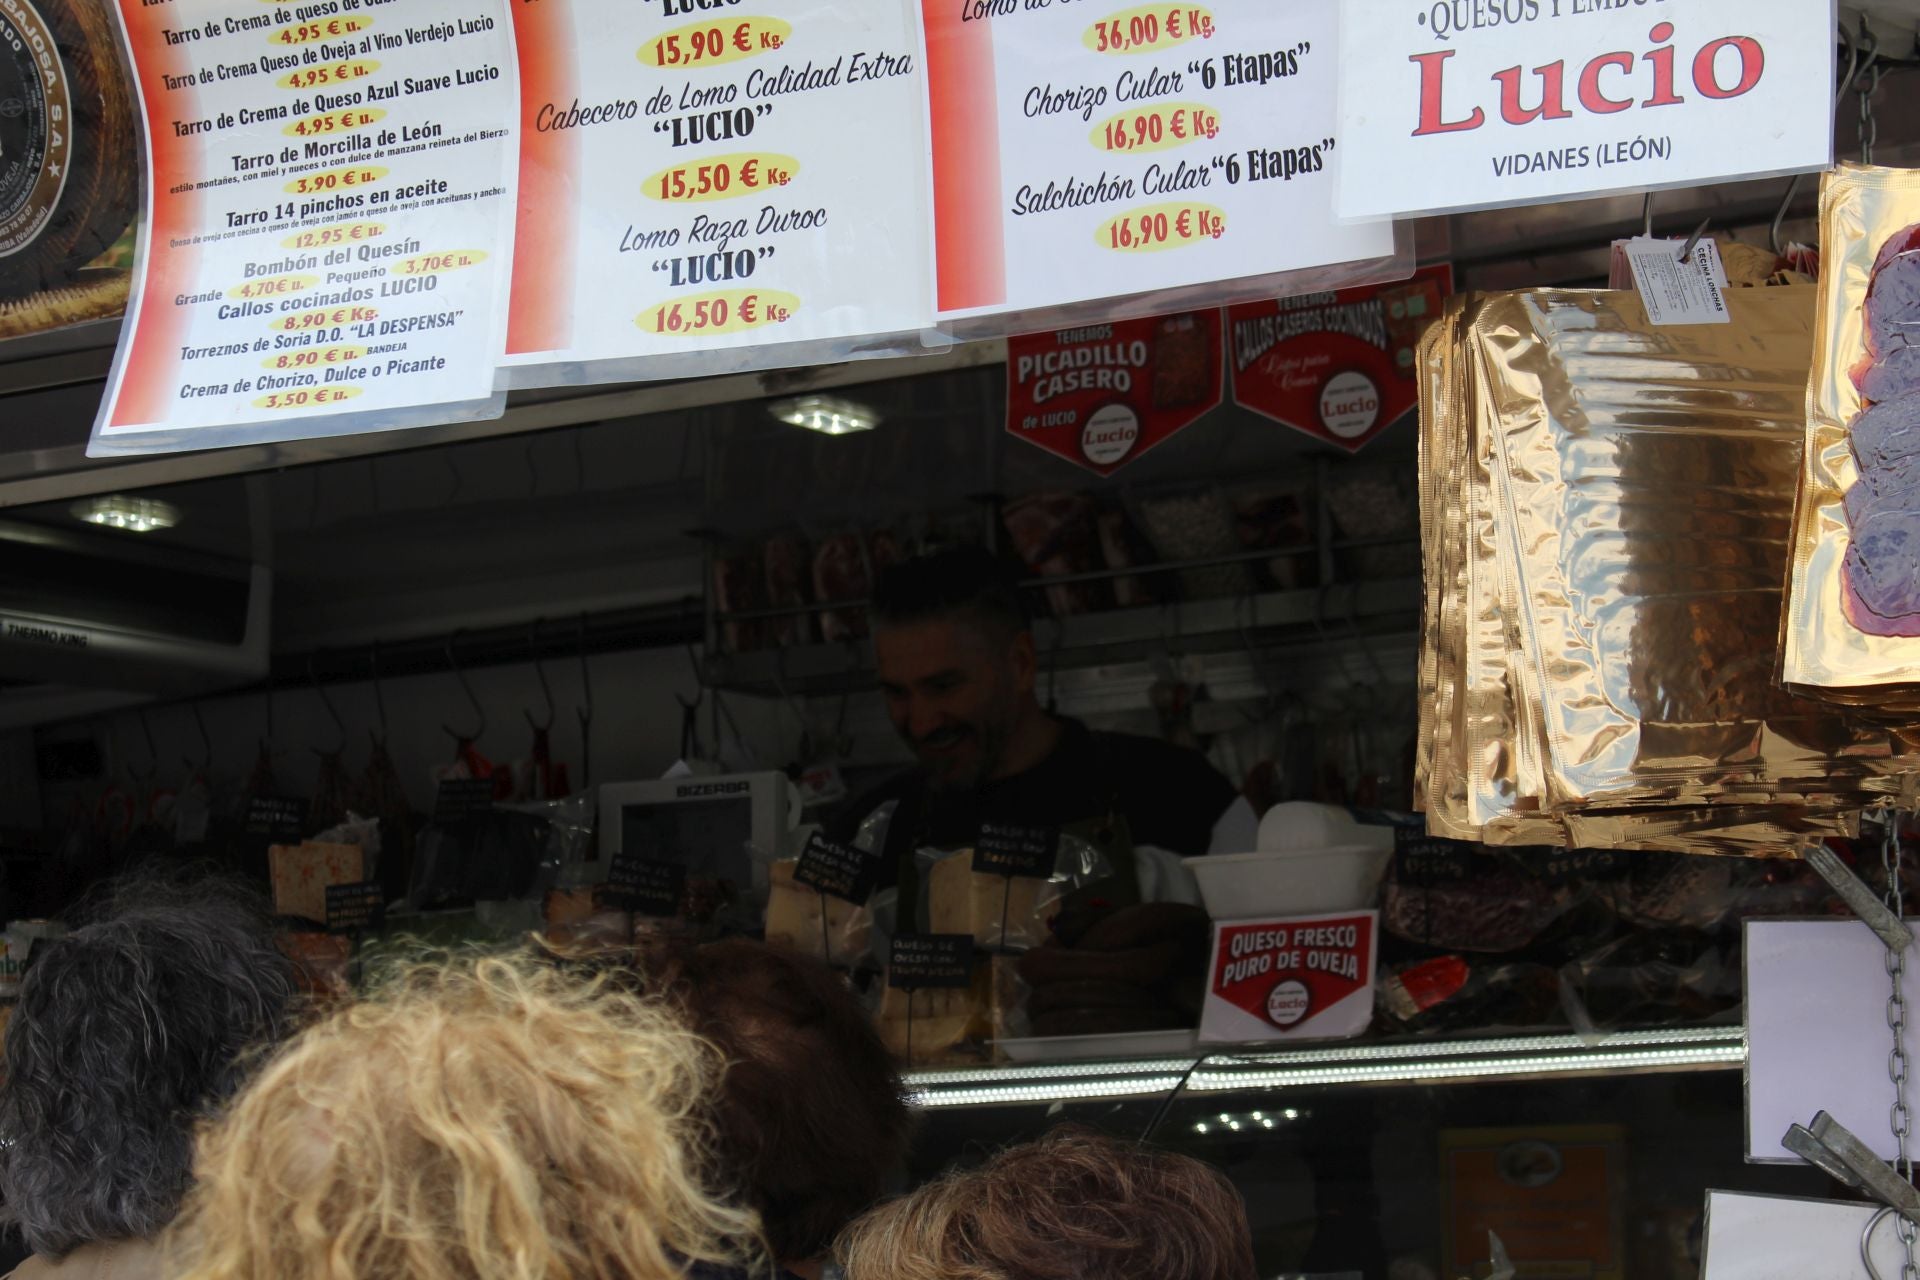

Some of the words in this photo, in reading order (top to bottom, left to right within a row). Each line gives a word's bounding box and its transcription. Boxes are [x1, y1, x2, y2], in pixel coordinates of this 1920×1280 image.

[162, 29, 200, 46] Tarro
[205, 22, 221, 38] de
[224, 13, 271, 36] Crema
[275, 8, 292, 24] de
[296, 3, 339, 24] queso
[281, 25, 320, 44] 4,95
[327, 20, 340, 35] €
[346, 20, 361, 33] u.
[962, 0, 1015, 22] Lomo
[1095, 20, 1158, 53] 36,00
[1165, 10, 1182, 38] €
[1189, 10, 1215, 38] Kg.
[0, 0, 56, 94] BAJOSA,
[162, 73, 196, 91] Tarro
[200, 68, 214, 83] de
[217, 61, 257, 80] Crema
[260, 53, 298, 75] Queso
[303, 50, 317, 65] de
[321, 41, 355, 62] Oveja
[360, 39, 371, 54] al
[374, 32, 402, 51] Vino
[407, 25, 454, 45] Verdejo
[458, 15, 494, 35] Lucio
[655, 30, 724, 66] 15,90
[733, 24, 752, 51] €
[760, 32, 783, 50] Kg.
[537, 99, 638, 132] Cabecero
[645, 86, 673, 114] de
[679, 83, 737, 111] Lomo
[746, 56, 842, 97] Calidad
[847, 51, 913, 83] Extra
[1024, 75, 1107, 121] Chorizo
[1115, 67, 1183, 102] Cular
[1409, 21, 1765, 136] Lucio
[172, 120, 211, 137] Tarro
[217, 114, 234, 129] de
[239, 106, 287, 126] Crema
[292, 101, 309, 116] de
[315, 92, 361, 113] Queso
[367, 82, 398, 102] Azul
[404, 75, 451, 96] Suave
[456, 64, 499, 86] Lucio
[232, 153, 274, 172] Tarro
[279, 148, 298, 164] de
[304, 134, 372, 158] Morcilla
[377, 129, 396, 146] de
[402, 121, 441, 142] León
[1105, 119, 1162, 151] 16,90
[1170, 110, 1185, 138] €
[1193, 109, 1219, 139] Kg.
[170, 183, 193, 194] estilo
[197, 176, 240, 189] montañes,
[243, 173, 258, 181] con
[261, 168, 278, 178] miel
[282, 168, 285, 176] y
[289, 162, 318, 173] nueces
[330, 158, 345, 166] con
[348, 153, 371, 163] dulce
[387, 143, 426, 156] manzana
[429, 137, 460, 149] reineta
[464, 132, 477, 142] del
[480, 129, 509, 140] Bierzo
[1492, 146, 1589, 177] VIDANES
[1597, 135, 1671, 167] (LEÓN)
[660, 164, 730, 199] 15,50
[739, 160, 759, 187] €
[768, 168, 791, 185] Kg.
[1011, 172, 1135, 216] Salchichón
[1142, 161, 1210, 196] Cular
[227, 212, 268, 227] Tarro
[274, 204, 294, 220] 14
[300, 193, 363, 219] pinchos
[370, 189, 389, 204] en
[395, 179, 447, 201] aceite
[620, 226, 679, 252] Lomo
[688, 215, 749, 251] Raza
[756, 206, 827, 235] Duroc
[1110, 218, 1167, 249] 16,90
[1175, 210, 1191, 239] €
[1199, 210, 1225, 239] Kg.
[244, 253, 318, 279] Bombón
[324, 248, 351, 267] del
[358, 238, 420, 263] Quesín
[175, 289, 222, 306] Grande
[240, 280, 288, 298] 4,70€
[291, 279, 304, 292] u.
[326, 267, 386, 285] Pequeño
[406, 254, 453, 274] 3,70€
[458, 254, 471, 267] u.
[217, 300, 274, 321] Callos
[280, 286, 373, 311] cocinados
[380, 275, 436, 298] LUCIO
[1277, 291, 1336, 311] TENEMOS
[1698, 248, 1710, 276] CECINA
[1706, 278, 1722, 312] LONCHAS
[284, 312, 325, 330] 8,90
[332, 310, 344, 324] €
[350, 305, 379, 323] Kg.
[656, 299, 728, 332] 16,50
[737, 296, 757, 322] €
[766, 305, 790, 321] Kg.
[1056, 325, 1112, 344] TENEMOS
[1235, 317, 1274, 371] CALLOS
[1275, 309, 1323, 341] CASEROS
[1324, 299, 1387, 350] COCINADOS
[181, 340, 248, 361] Torreznos
[253, 337, 269, 352] de
[274, 329, 311, 348] Soria
[315, 326, 344, 344] D.O.
[276, 352, 318, 369] 8,90
[324, 350, 337, 363] €
[343, 349, 358, 361] u.
[367, 342, 407, 356] BANDEJA
[1018, 340, 1147, 384] PICADILLO
[180, 381, 228, 399] Crema
[233, 378, 251, 393] de
[256, 371, 318, 392] Chorizo,
[324, 365, 366, 383] Dulce
[372, 365, 381, 377] o
[387, 356, 445, 375] Picante
[1033, 369, 1131, 404] CASERO
[266, 392, 308, 409] 3,50
[314, 389, 327, 402] €
[333, 389, 348, 401] u.
[1023, 417, 1037, 429] de
[1042, 410, 1076, 427] LUCIO
[1323, 396, 1376, 418] Lucio
[1084, 427, 1135, 445] Lucio
[8, 624, 57, 637] THERMO
[57, 633, 87, 647] KING
[677, 781, 749, 797] BIZERBA
[1232, 929, 1287, 958] QUESO
[1293, 925, 1356, 948] FRESCO
[1223, 955, 1271, 988] PURO
[1277, 950, 1300, 969] DE
[1307, 950, 1358, 979] OVEJA
[1270, 998, 1307, 1009] Lucio
